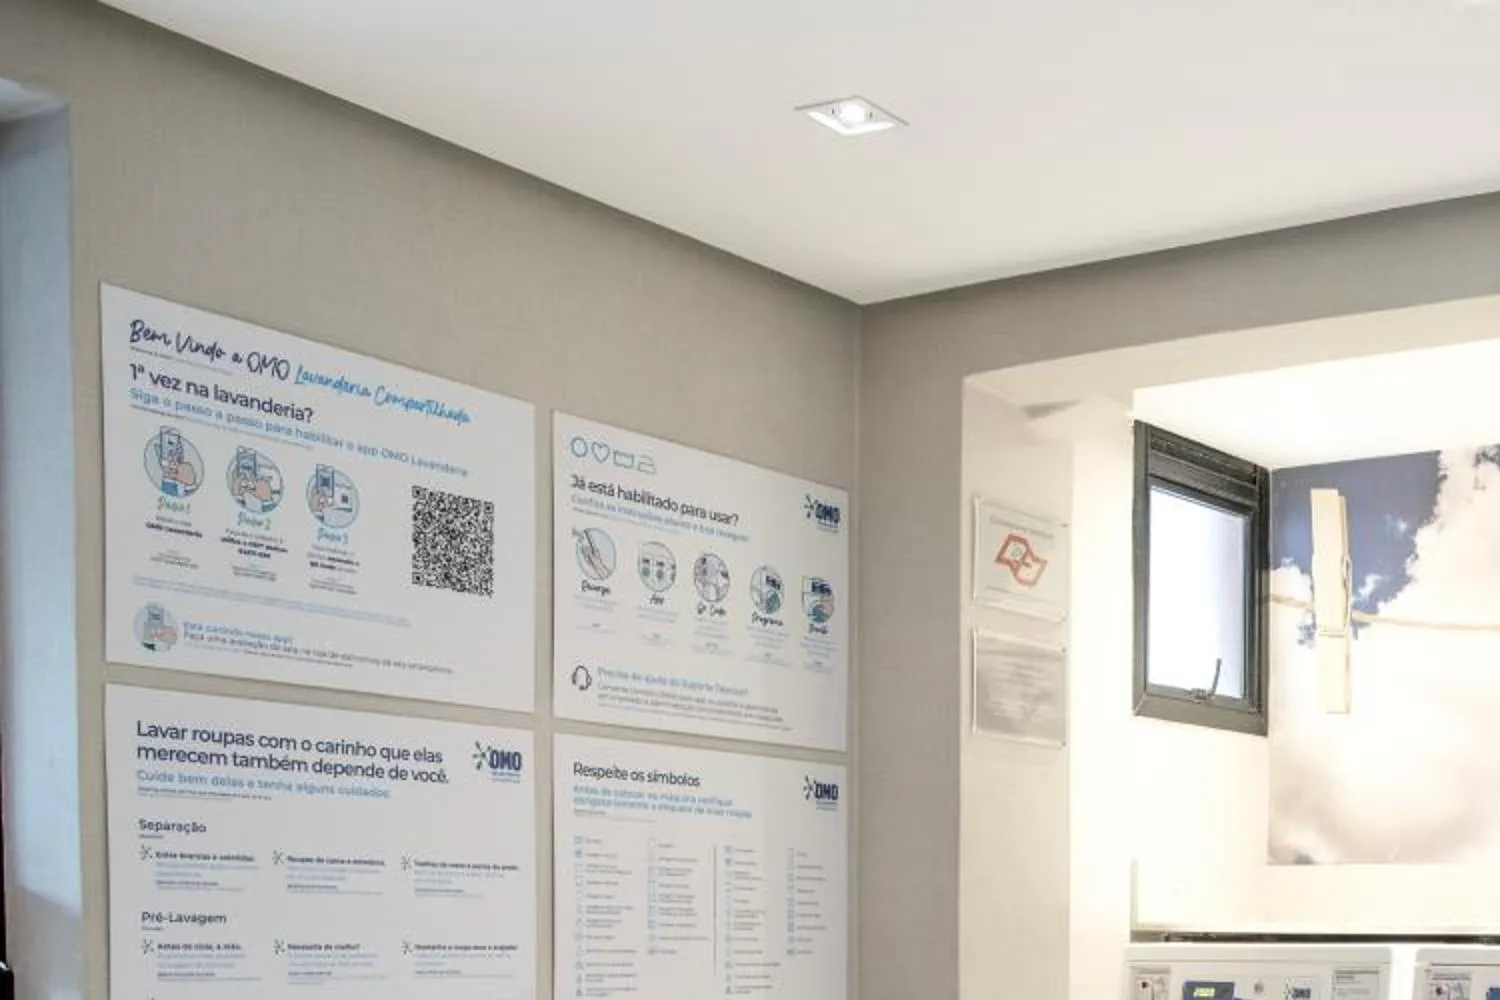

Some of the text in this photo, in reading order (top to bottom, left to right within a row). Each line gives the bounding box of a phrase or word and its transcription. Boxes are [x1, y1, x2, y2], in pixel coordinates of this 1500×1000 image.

[129, 319, 172, 346] Bem
[175, 331, 227, 362] Vindo
[231, 352, 243, 365] a
[247, 351, 290, 381] OMO
[294, 363, 372, 398] Lavanderia
[149, 371, 181, 392] vez
[185, 381, 209, 399] na
[213, 384, 314, 424] lavanderia?
[175, 400, 213, 416] passo
[227, 413, 264, 430] passo
[571, 474, 739, 527] Já está habilitado para usar?
[137, 720, 443, 764] Lavar roupas com o carinho que elas
[137, 745, 449, 784] merecem também depende de você.
[488, 749, 522, 771] OMO
[137, 769, 174, 783] Cuide
[178, 772, 208, 785] bem
[573, 761, 701, 788] Respeite os símbolos
[815, 783, 839, 801] OMO
[138, 818, 207, 835] Separação
[141, 911, 228, 926] Pré-Lavagem
